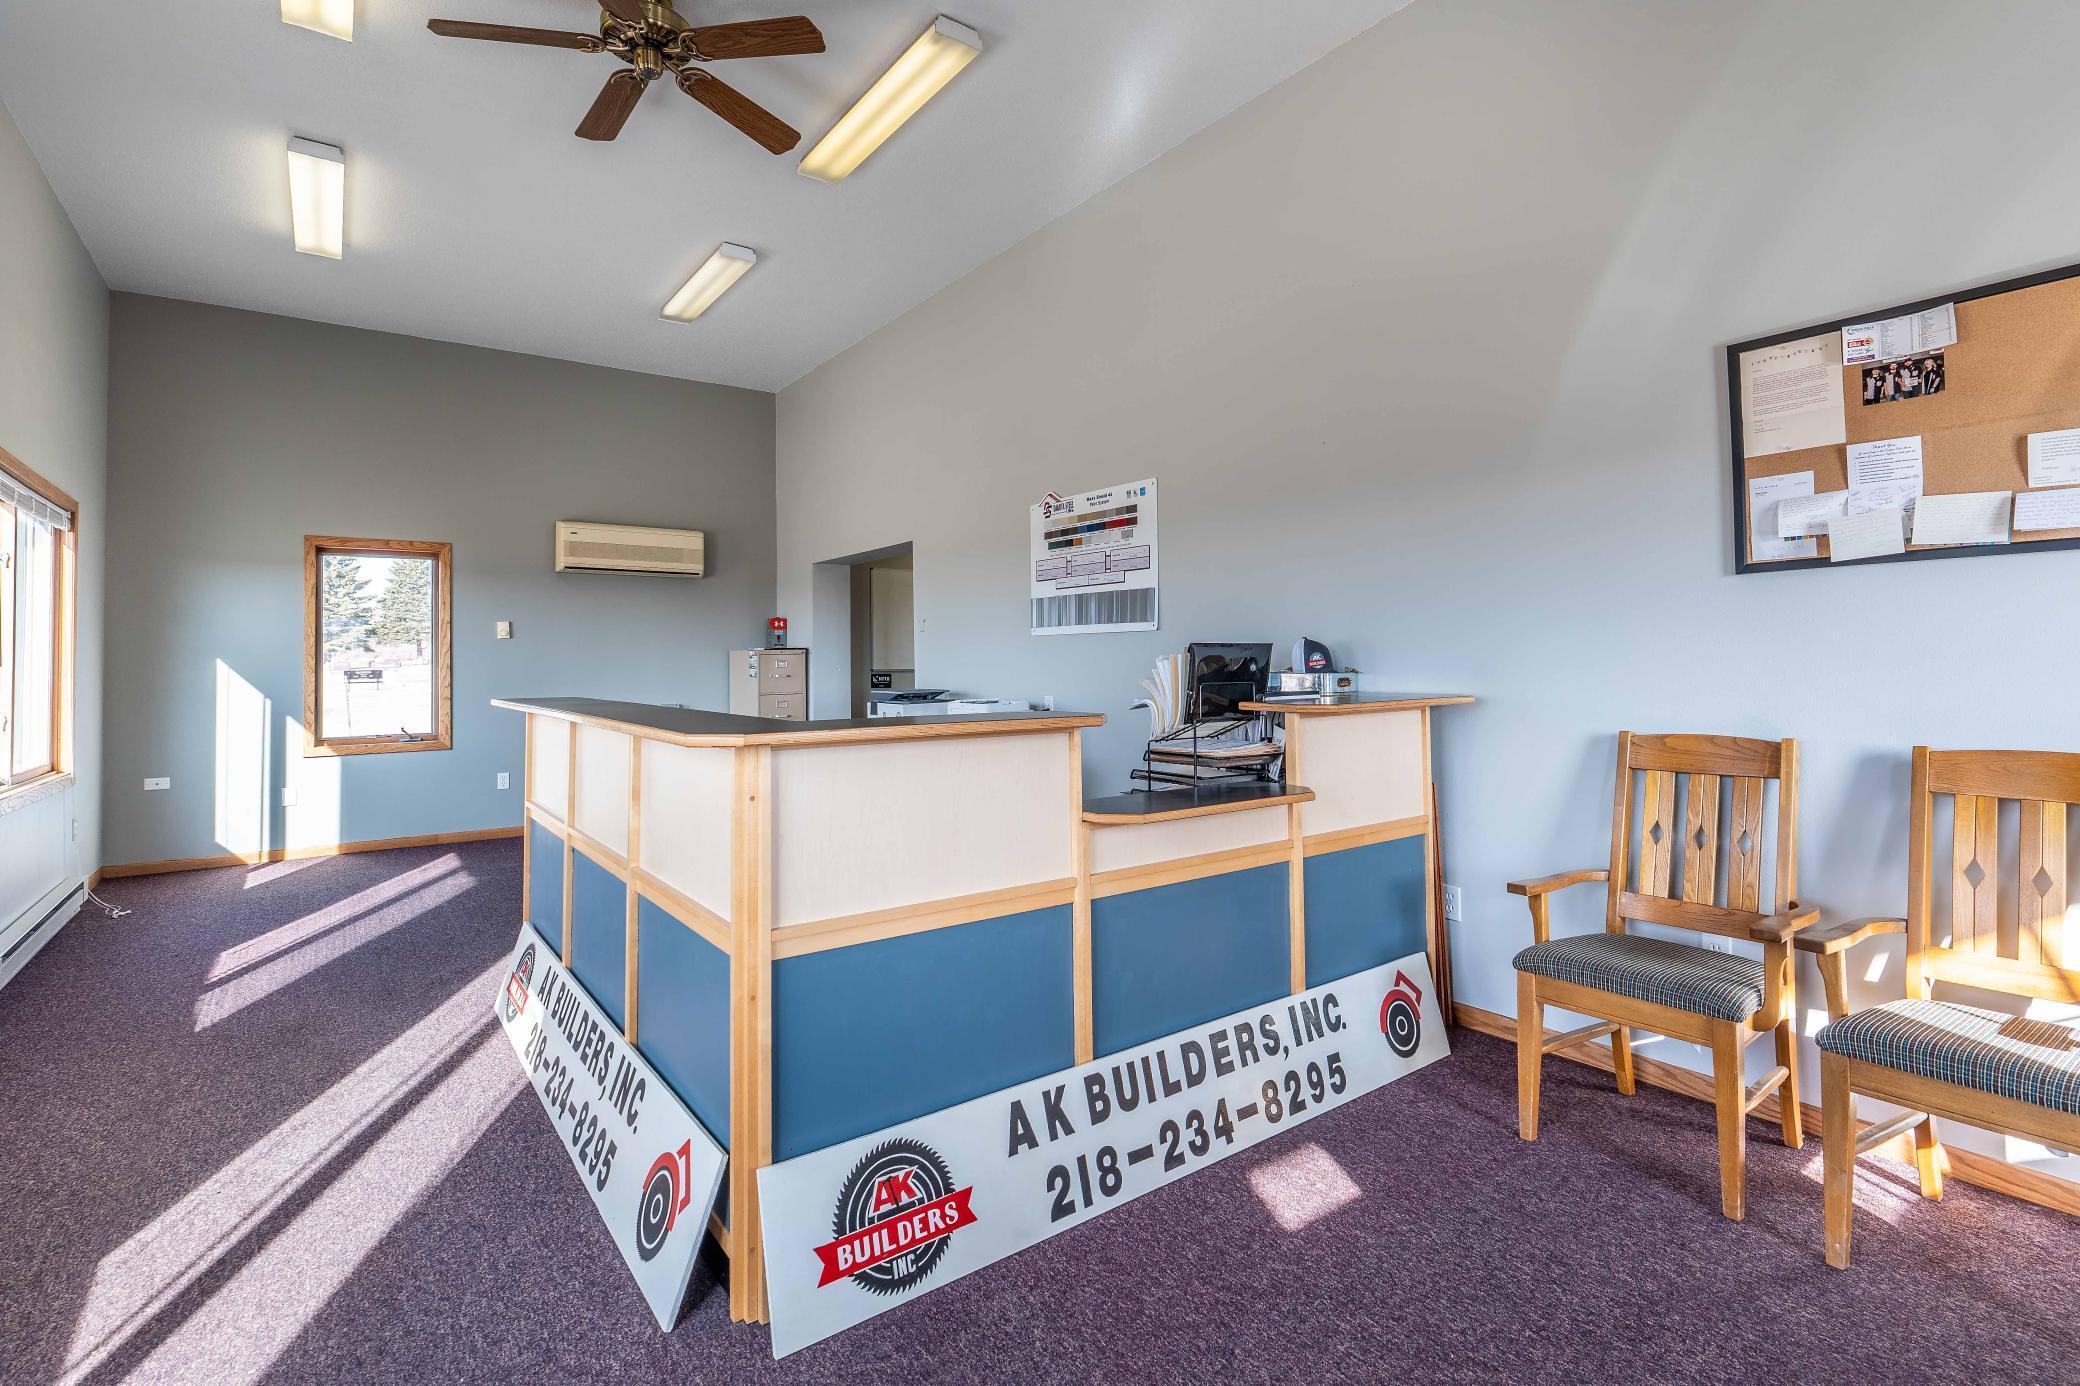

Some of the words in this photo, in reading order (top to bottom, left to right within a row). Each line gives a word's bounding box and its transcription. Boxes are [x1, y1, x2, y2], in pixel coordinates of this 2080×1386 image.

[537, 965, 559, 1010] AK
[526, 1022, 618, 1193] 218-234-8295
[1046, 1051, 1347, 1223] 218-234-8295
[871, 1166, 920, 1216] AK
[837, 1201, 960, 1272] BUILDERS
[892, 1252, 918, 1280] INC
